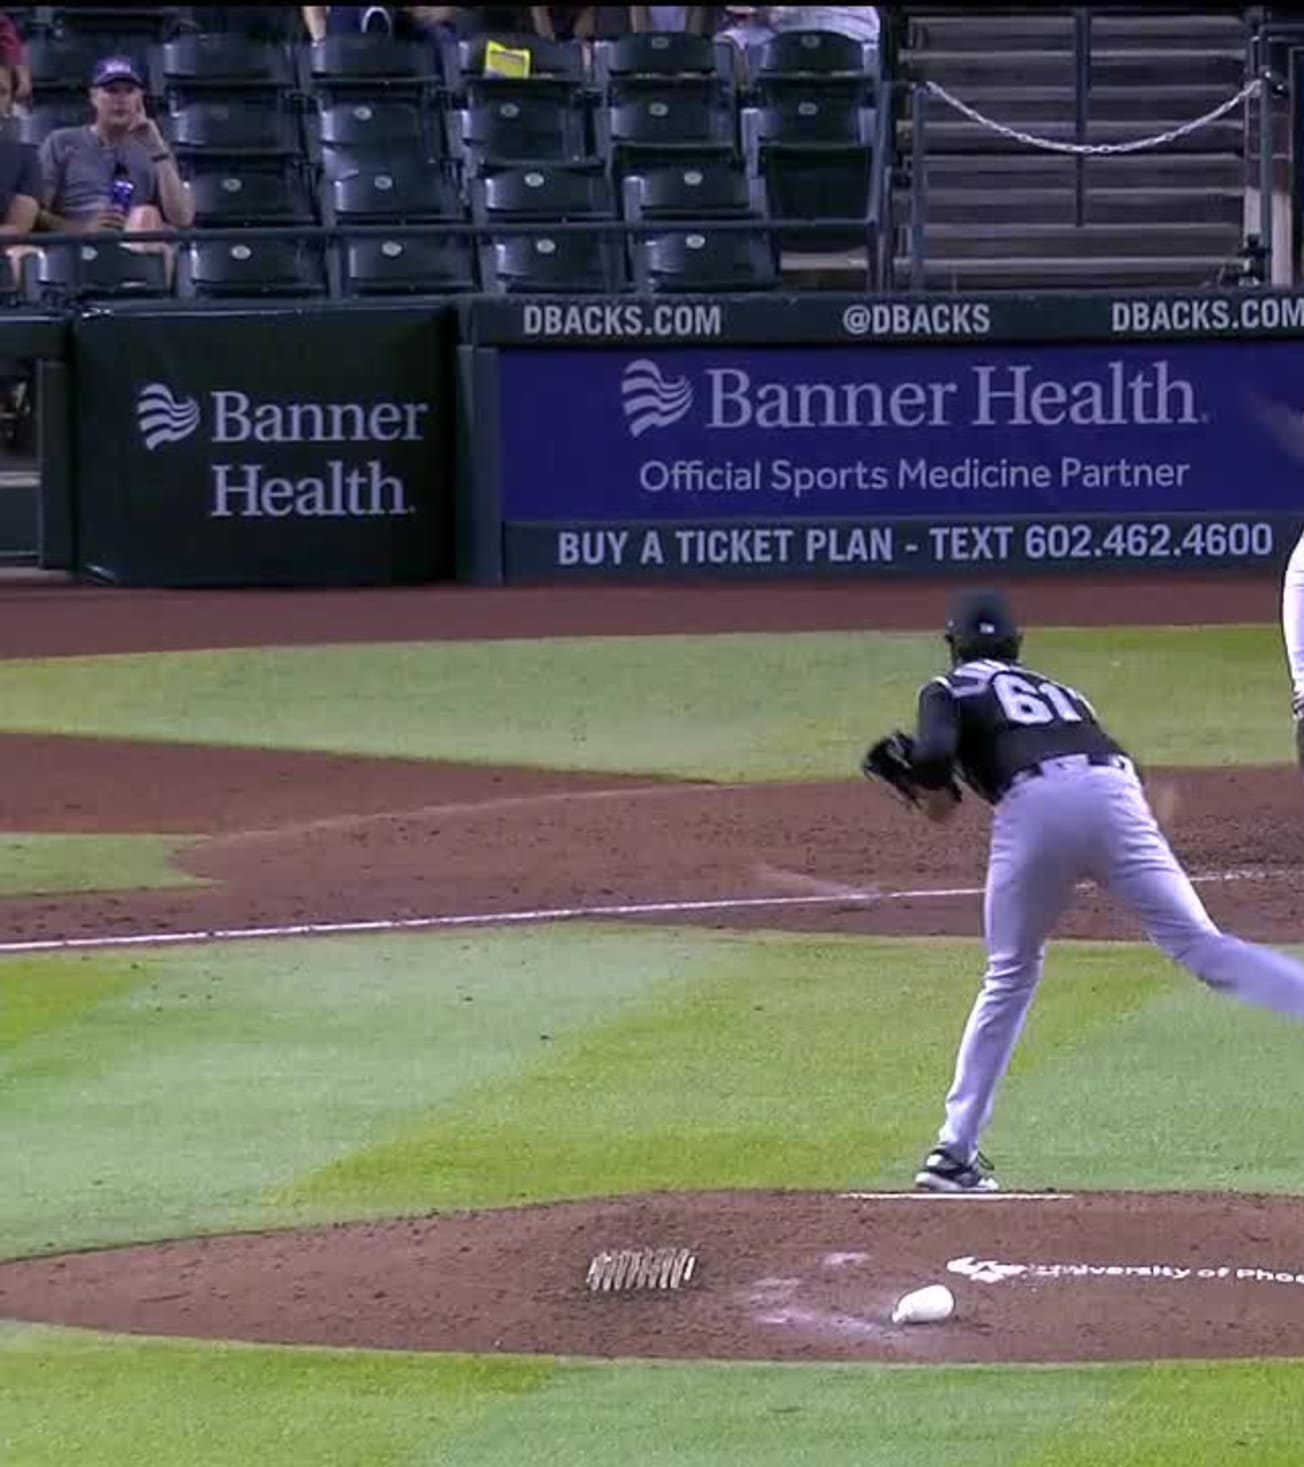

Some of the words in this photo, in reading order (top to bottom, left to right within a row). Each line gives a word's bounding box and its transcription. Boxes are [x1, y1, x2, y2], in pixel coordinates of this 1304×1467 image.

[524, 305, 721, 335] DBACKS.COM
[843, 304, 991, 334] @DBACKS
[210, 390, 429, 443] Banner
[704, 367, 957, 429] Banner
[639, 460, 761, 492] Official
[771, 459, 888, 498] Sports
[898, 457, 1051, 489] Medicine
[1061, 456, 1190, 488] Partner
[558, 531, 628, 565] BUY
[640, 531, 664, 563] A
[675, 528, 793, 564] TICKET
[806, 527, 893, 562] PLAN
[929, 525, 1013, 560] TEXT
[1025, 522, 1273, 558] 602.462.4600
[991, 672, 1083, 726] 61
[1196, 1266, 1230, 1278] of
